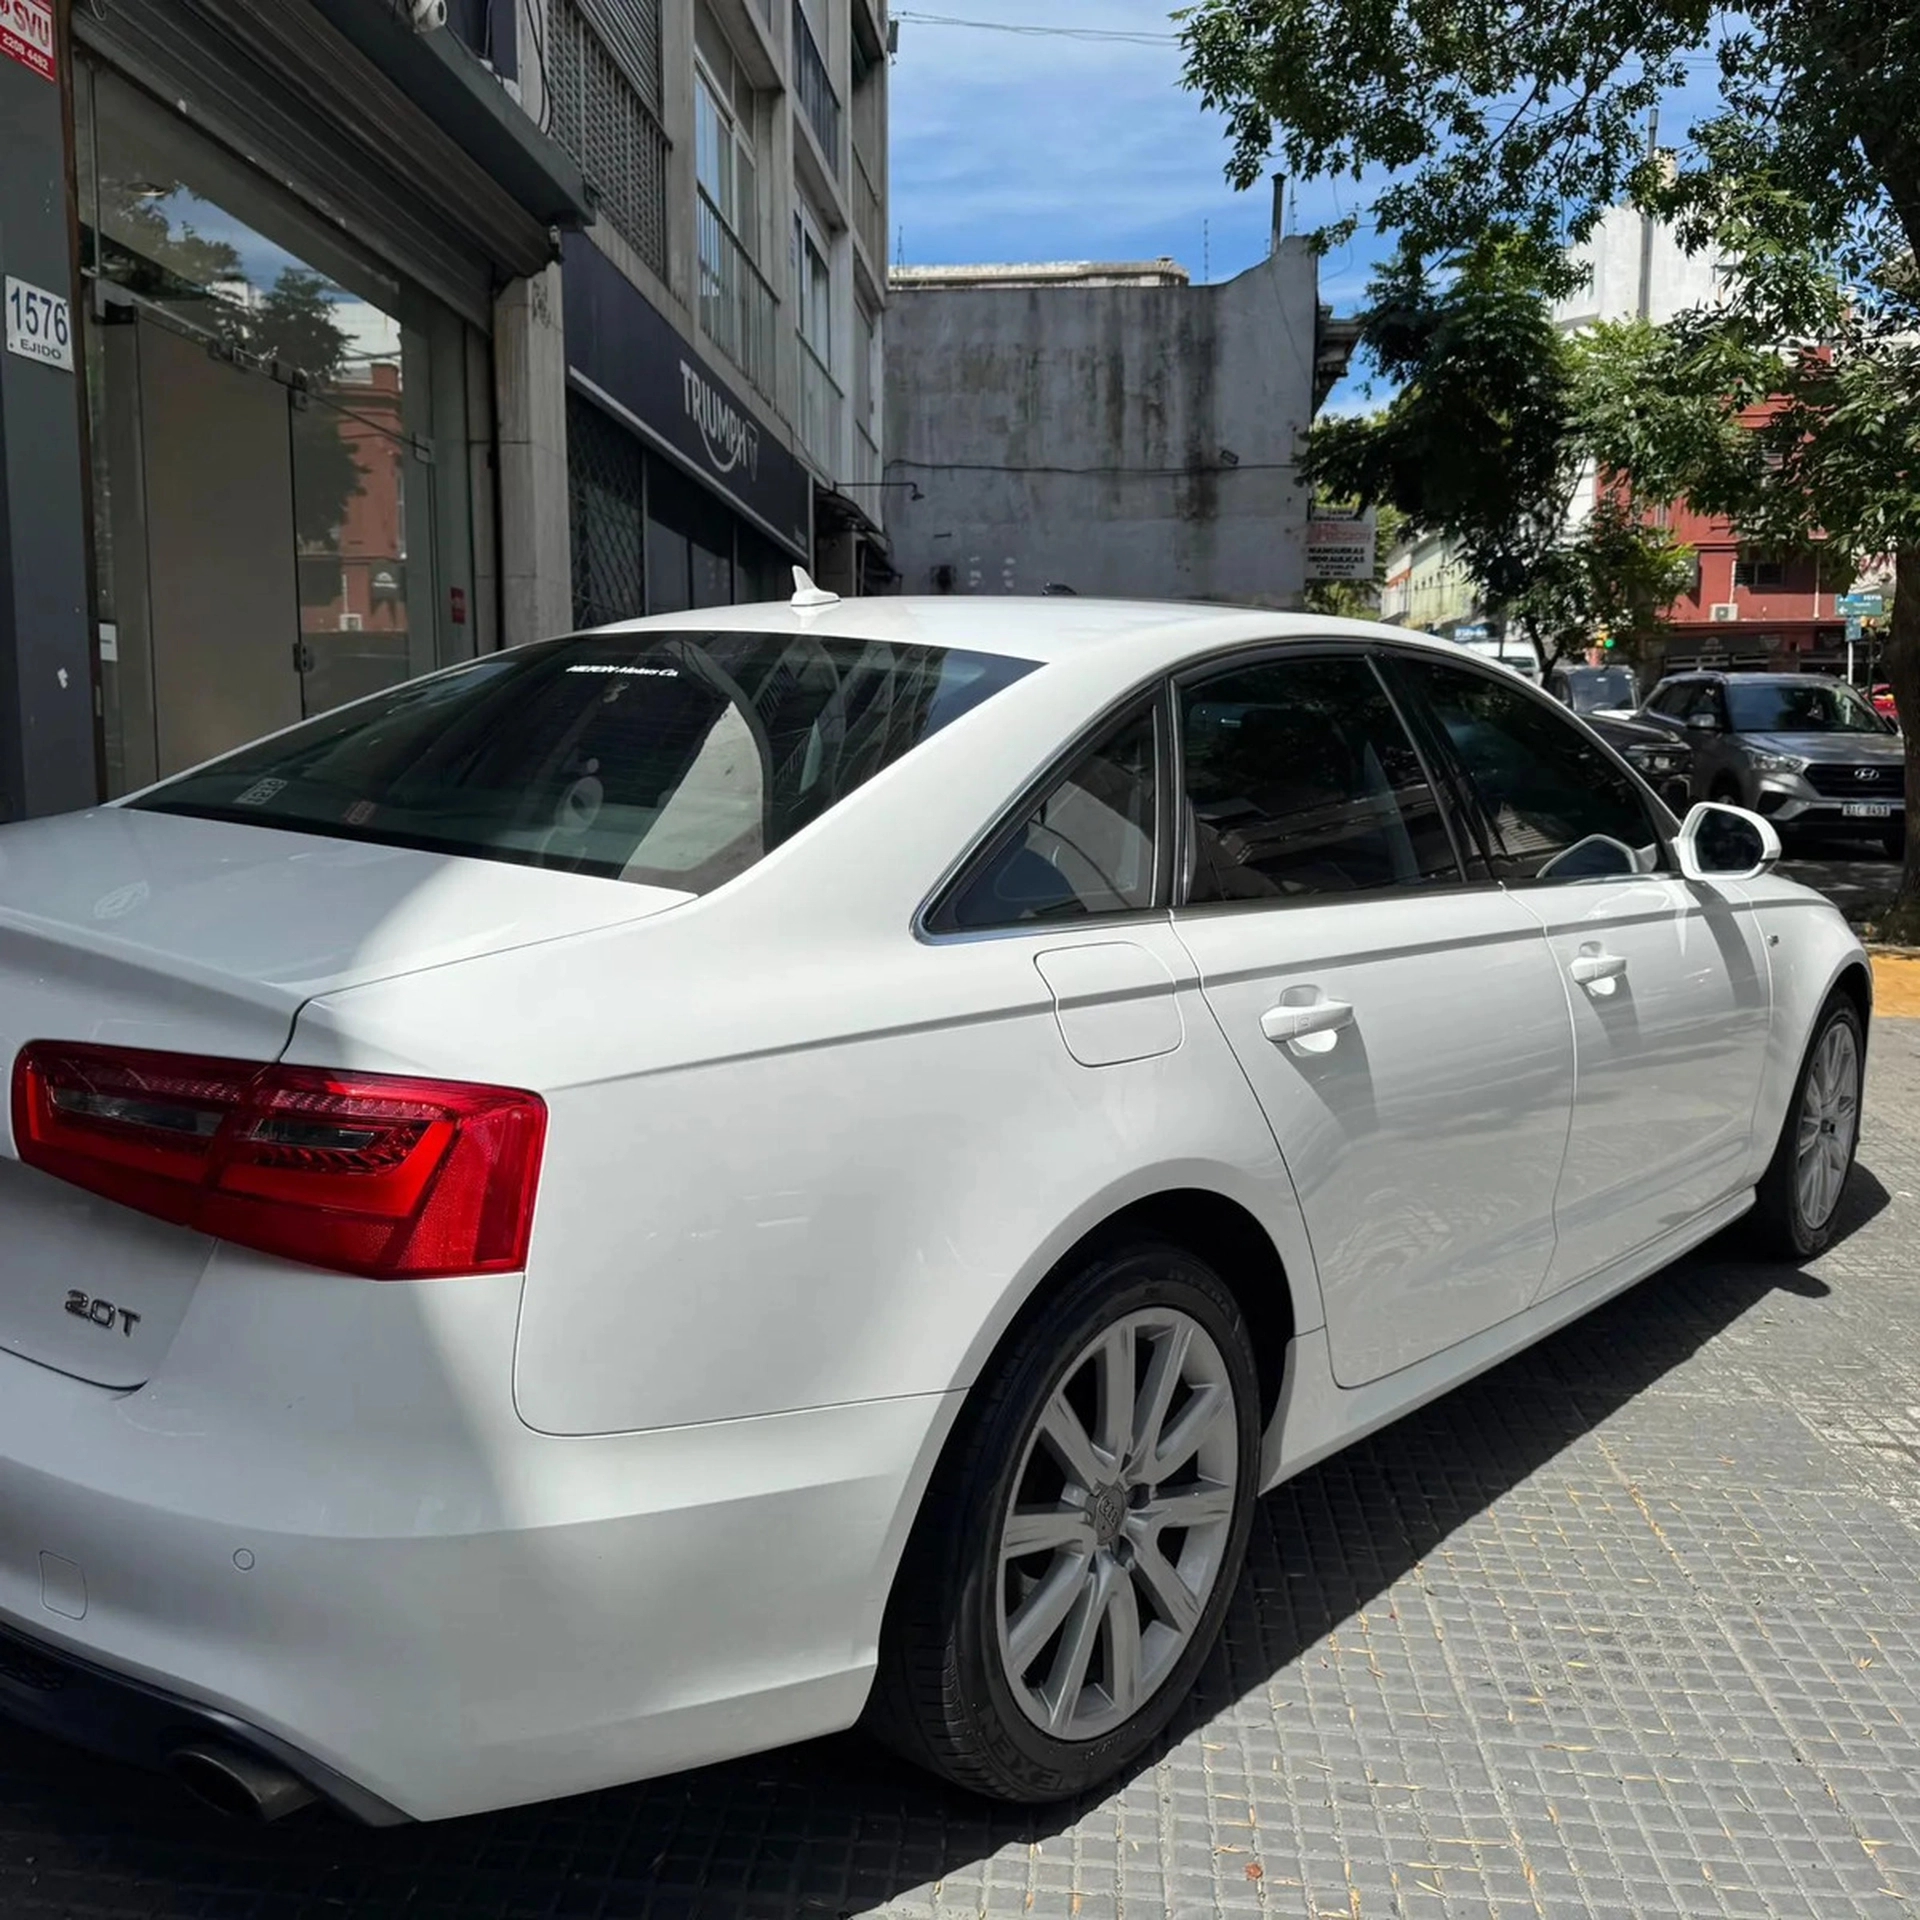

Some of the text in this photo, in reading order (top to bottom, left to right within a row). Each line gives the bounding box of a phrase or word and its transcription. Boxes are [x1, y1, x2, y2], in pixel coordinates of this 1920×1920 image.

[13, 0, 49, 47] SVU
[11, 286, 68, 346] 1576
[20, 339, 62, 360] EJIDO
[680, 359, 748, 473] TRIUMPH
